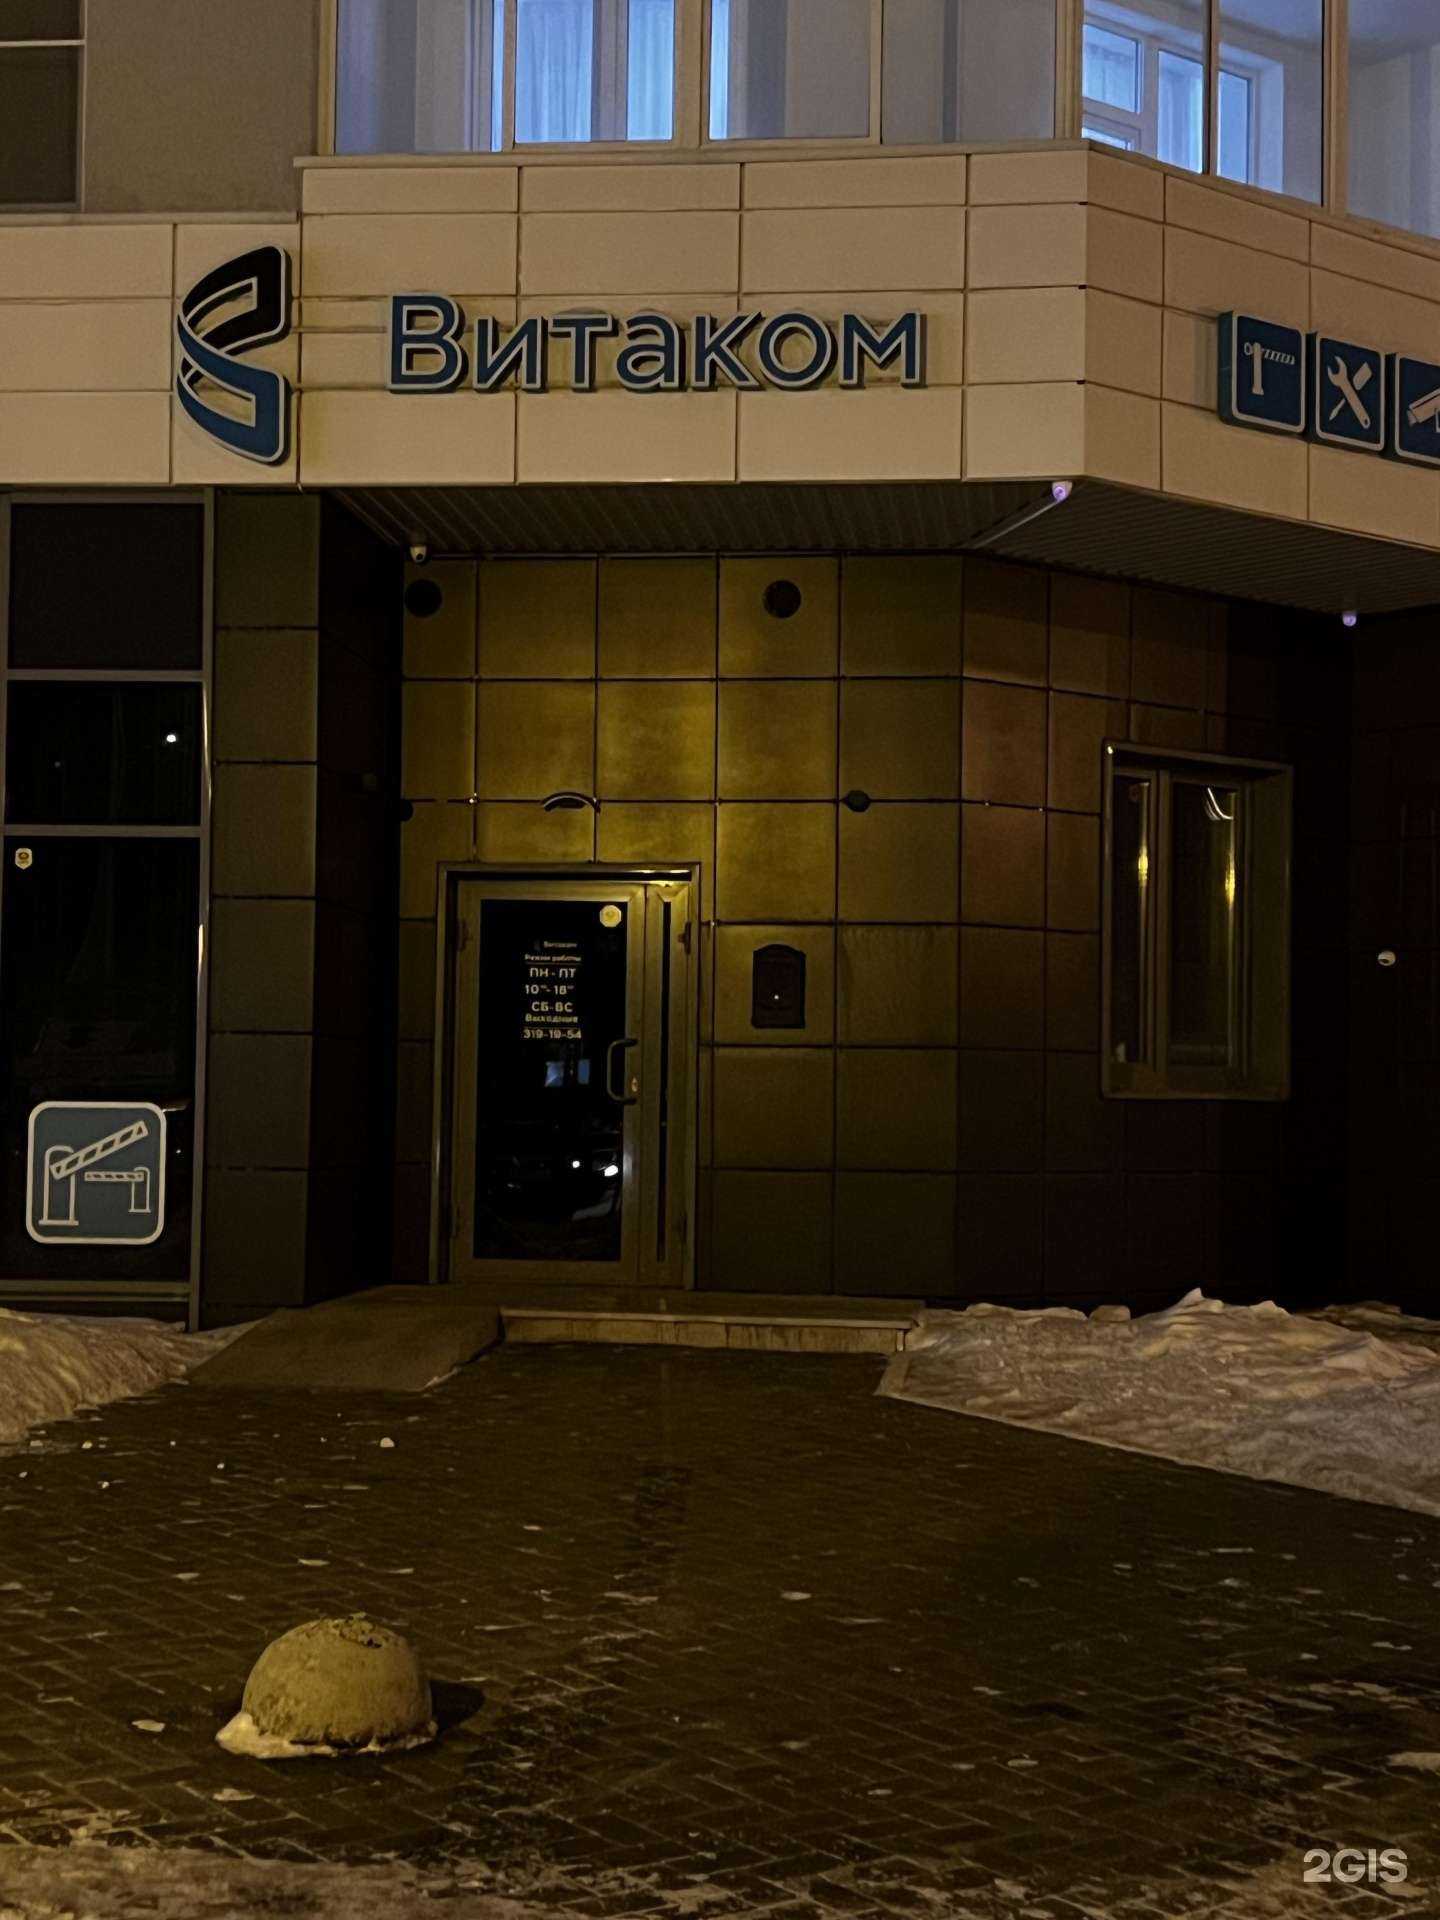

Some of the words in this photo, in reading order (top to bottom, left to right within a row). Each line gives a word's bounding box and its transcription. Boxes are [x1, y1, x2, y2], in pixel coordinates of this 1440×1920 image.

[388, 294, 924, 391] Витаком
[529, 967, 549, 978] ПН
[559, 968, 577, 978] ПТ
